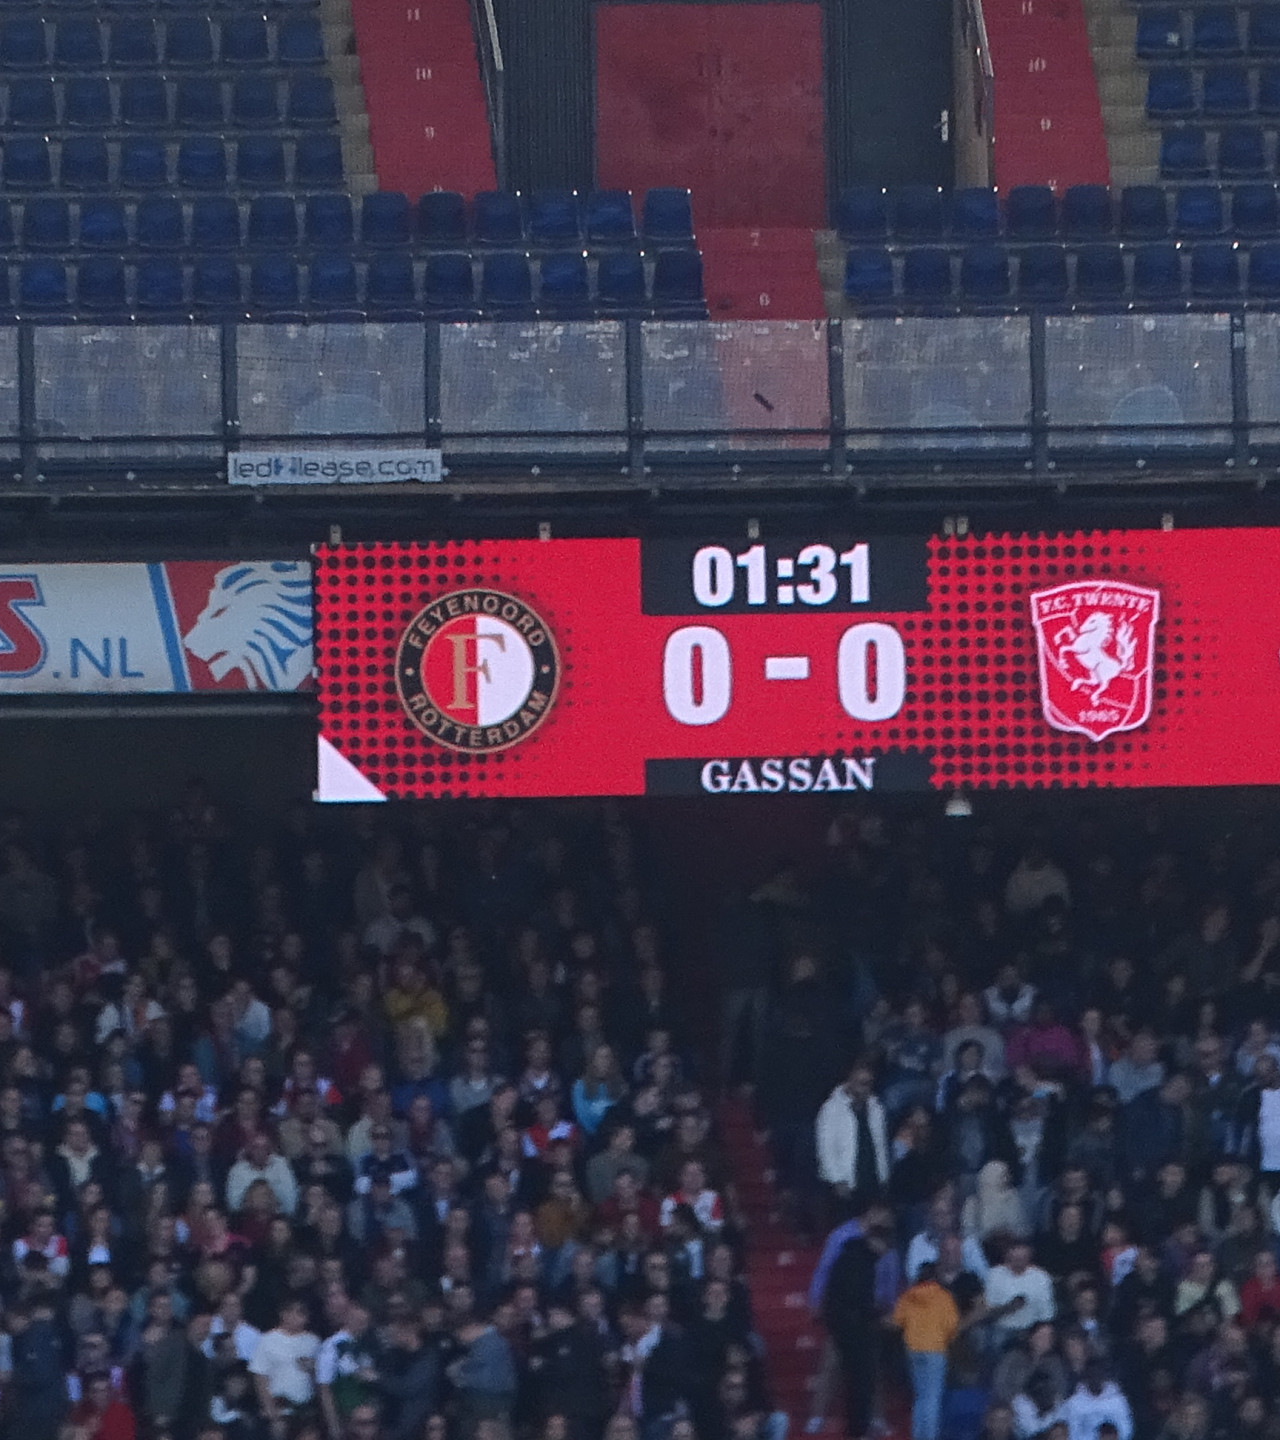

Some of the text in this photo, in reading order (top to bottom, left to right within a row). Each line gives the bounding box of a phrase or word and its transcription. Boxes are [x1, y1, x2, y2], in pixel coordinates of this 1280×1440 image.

[693, 543, 870, 607] 01:31
[408, 594, 546, 649] FEYENOORD
[444, 632, 507, 710] F
[663, 624, 732, 726] 0
[837, 621, 906, 722] 0
[408, 690, 549, 746] ROTTERDAM
[701, 757, 876, 793] GASSAN
